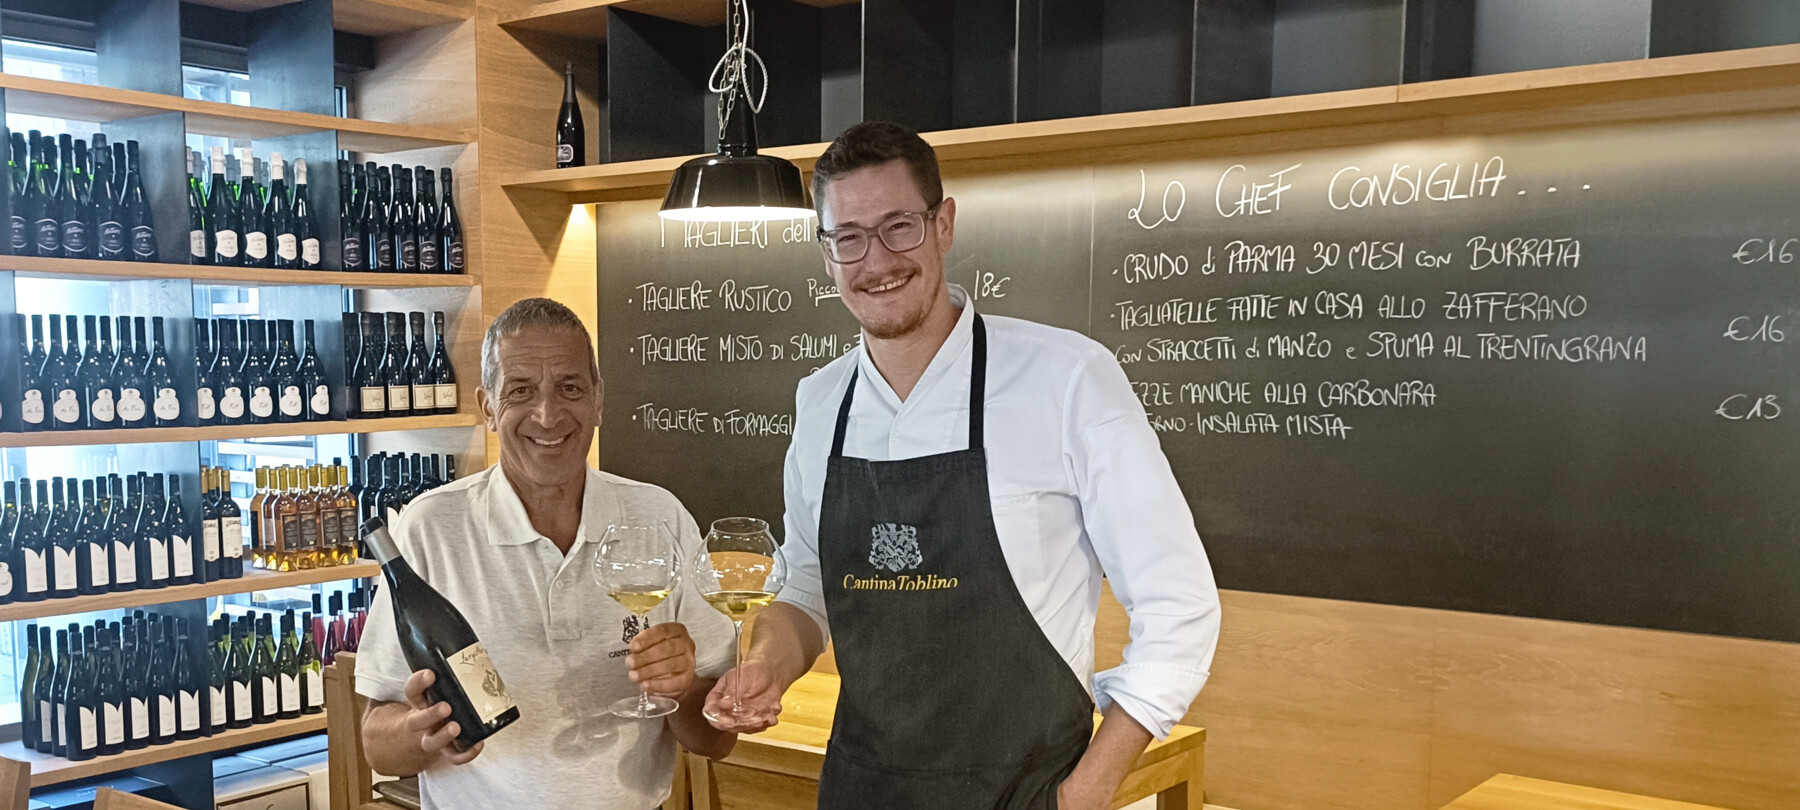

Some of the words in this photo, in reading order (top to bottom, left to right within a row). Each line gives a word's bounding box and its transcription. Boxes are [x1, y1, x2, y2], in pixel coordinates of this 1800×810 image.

[1128, 168, 1186, 230] LO
[1215, 164, 1302, 217] CHEF
[1123, 253, 1189, 284] CRUDO
[1201, 246, 1216, 276] di
[1223, 240, 1296, 275] PARMA
[1306, 242, 1341, 275] 30
[1349, 240, 1405, 271] MESI
[1466, 236, 1581, 271] BURRATA
[1731, 238, 1799, 265] €16
[636, 280, 713, 312] TAGLIERE
[718, 279, 792, 313] RUSTICO
[974, 269, 1011, 301] 18€
[1115, 298, 1223, 331] TAGLIATELLE
[1287, 296, 1309, 318] IN
[1314, 290, 1364, 320] CASA
[1377, 294, 1426, 319] ALLO
[1442, 291, 1588, 323] ZAFFERANO
[1723, 314, 1785, 343] €16
[637, 333, 710, 366] TAGLIERE
[719, 333, 763, 363] MISTO
[769, 343, 784, 361] DI
[789, 332, 838, 362] SALUMI
[1146, 335, 1238, 363] STRACCETTI
[1244, 336, 1261, 359] di
[1268, 332, 1332, 359] MANZO
[1345, 346, 1358, 360] e
[1366, 331, 1435, 360] SPUMA
[1442, 335, 1472, 359] AL
[1476, 333, 1647, 363] TRENTINGRANA
[1179, 380, 1252, 405] MANICHE
[1263, 382, 1307, 406] ALLA
[1317, 378, 1438, 408] CARBONARA
[636, 402, 709, 435] TAGLIERE
[724, 409, 793, 438] FORMAGGI
[1196, 411, 1281, 437] INSALATA
[1286, 413, 1354, 440] MISTA
